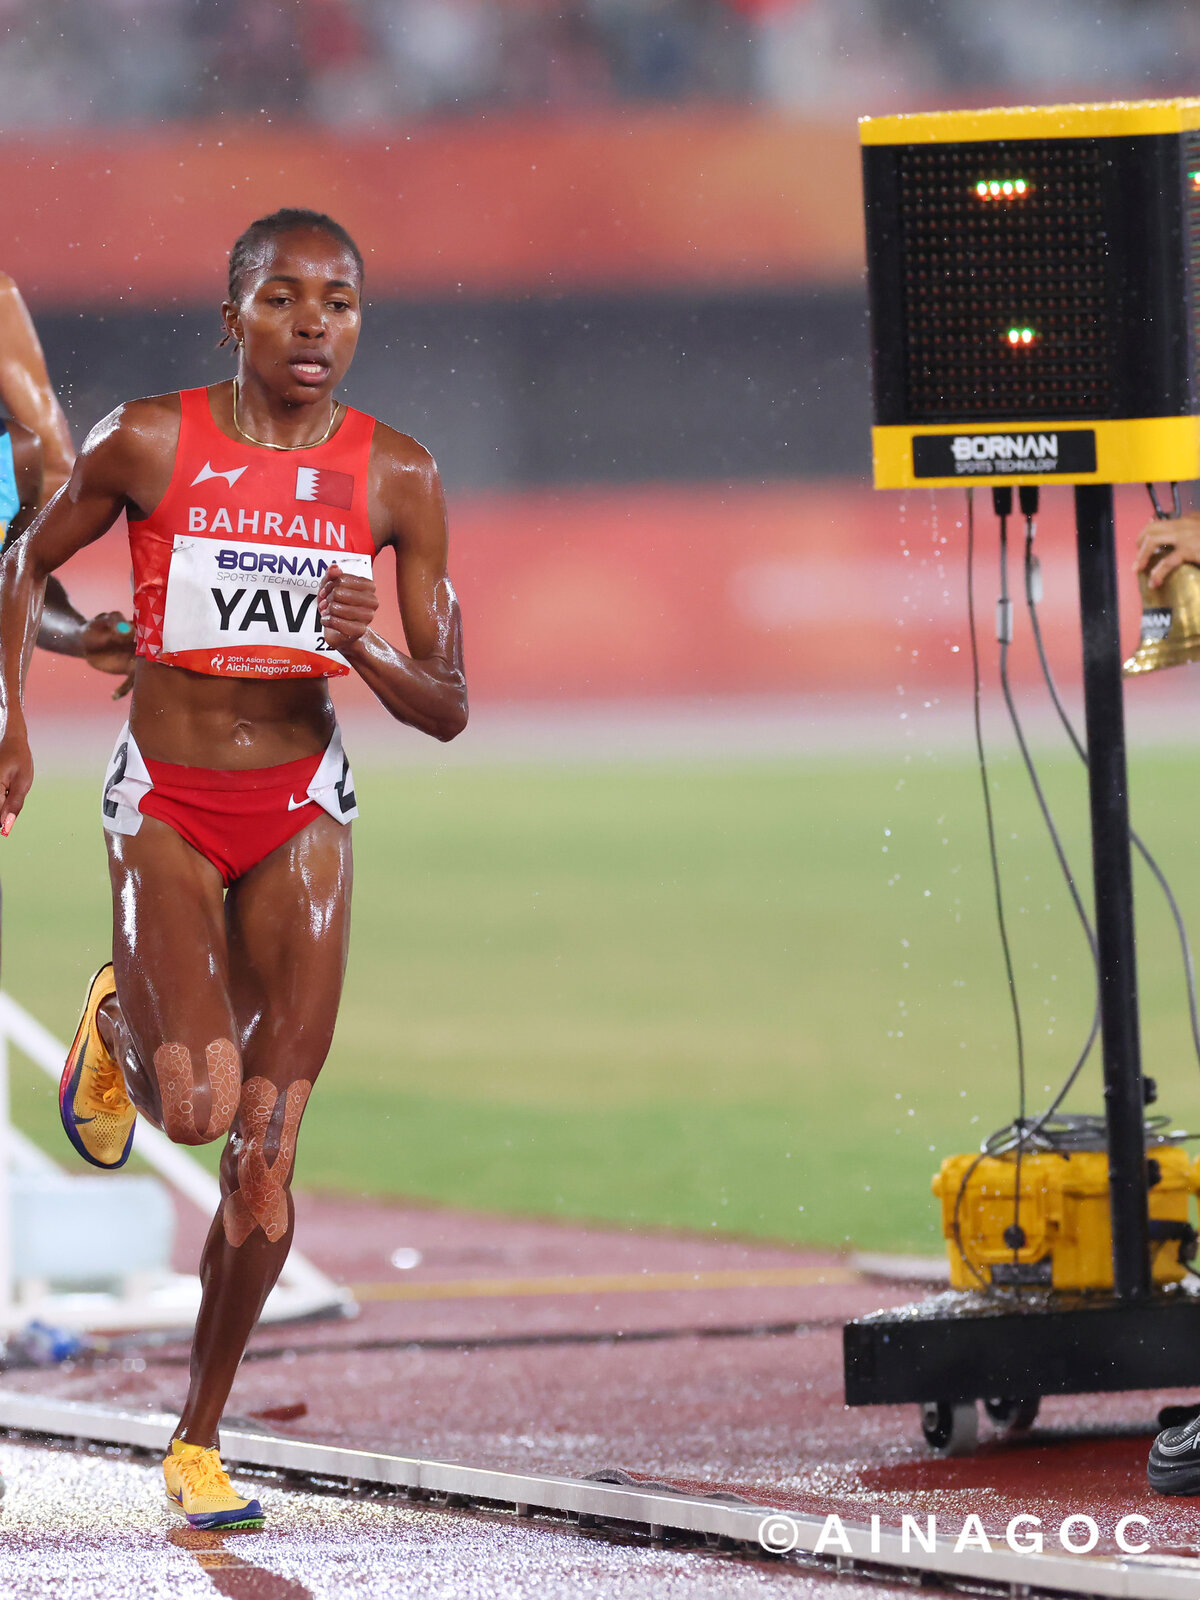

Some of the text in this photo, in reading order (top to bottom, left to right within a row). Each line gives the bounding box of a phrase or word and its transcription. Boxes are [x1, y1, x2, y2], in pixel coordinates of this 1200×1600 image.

[952, 434, 1058, 461] BORNAN
[188, 506, 346, 549] BAHRAIN
[217, 571, 321, 589] SPORTS TECHNOLO
[226, 662, 312, 675] Aichi-Nagoya 2026
[227, 655, 291, 665] 20th Asian Games
